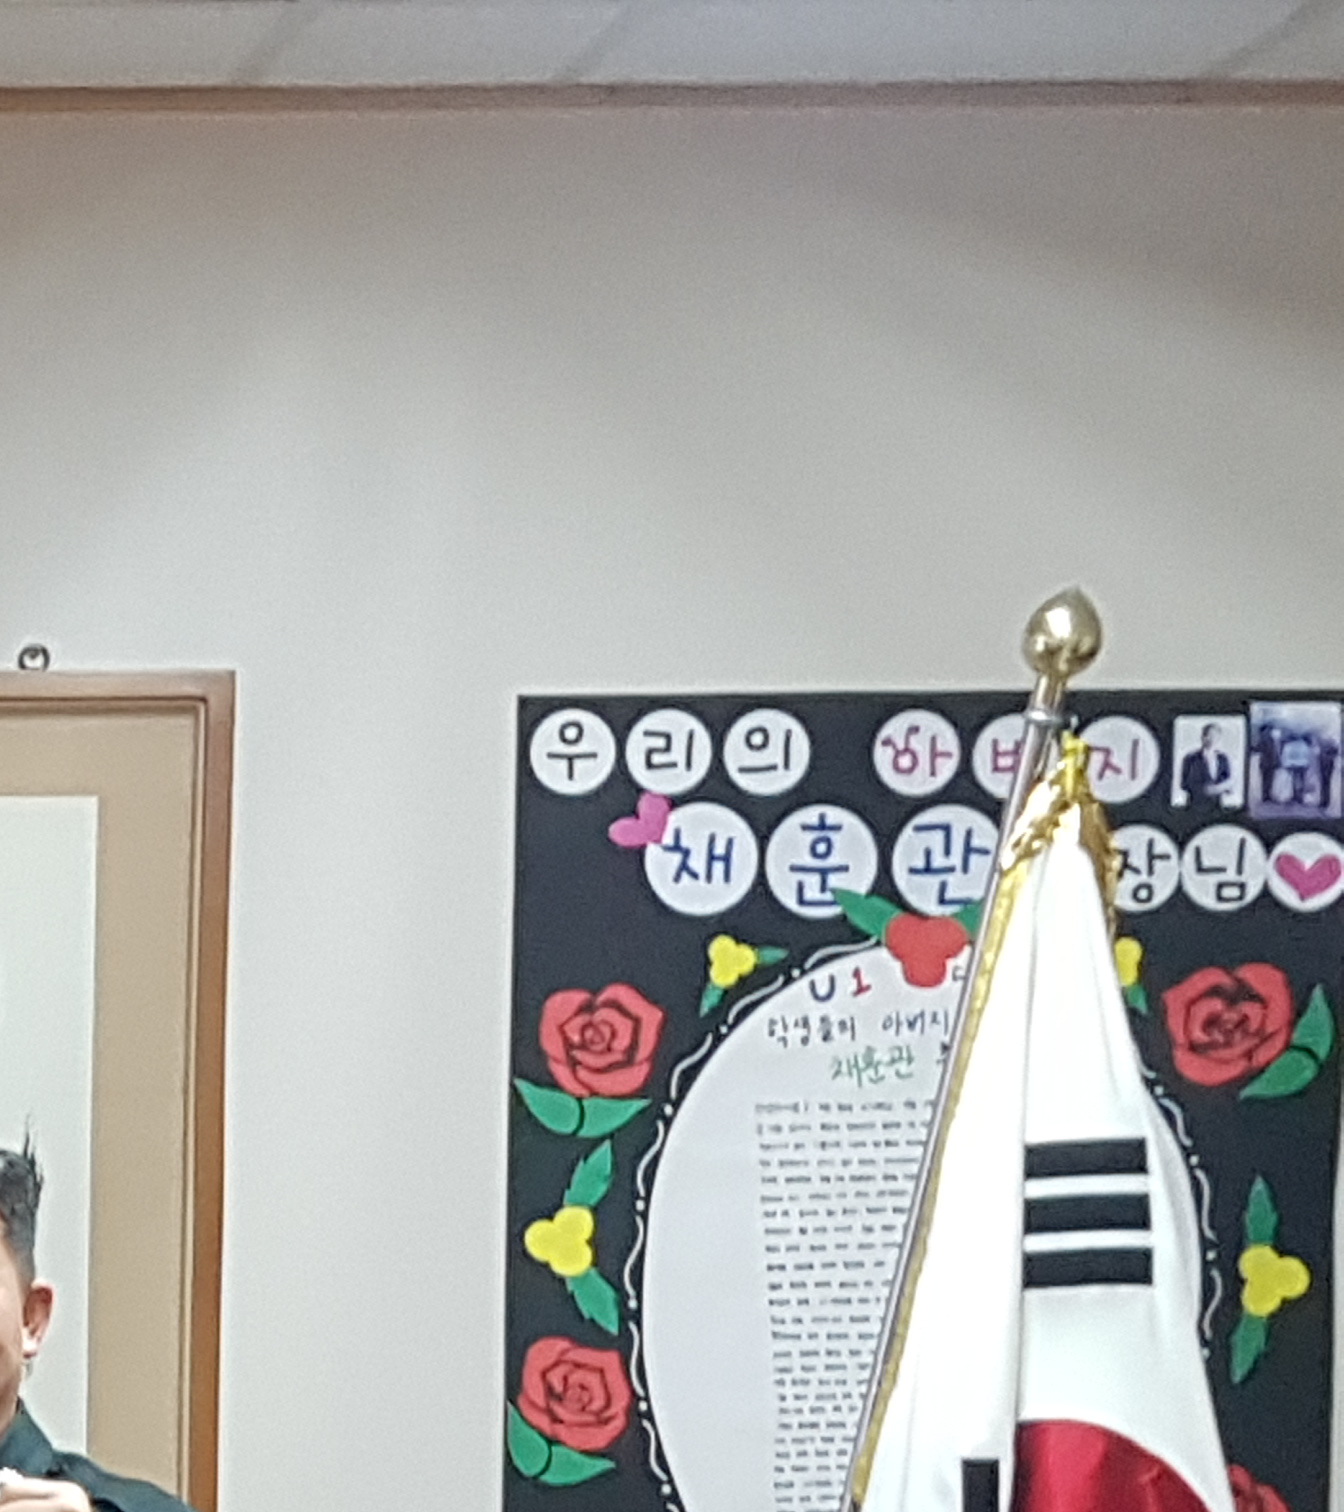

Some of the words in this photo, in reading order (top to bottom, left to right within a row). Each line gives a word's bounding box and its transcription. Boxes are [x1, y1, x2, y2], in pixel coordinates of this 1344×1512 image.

[545, 720, 792, 782] 우리의
[662, 811, 991, 906] 채훈관
[882, 1008, 950, 1037] 아버지
